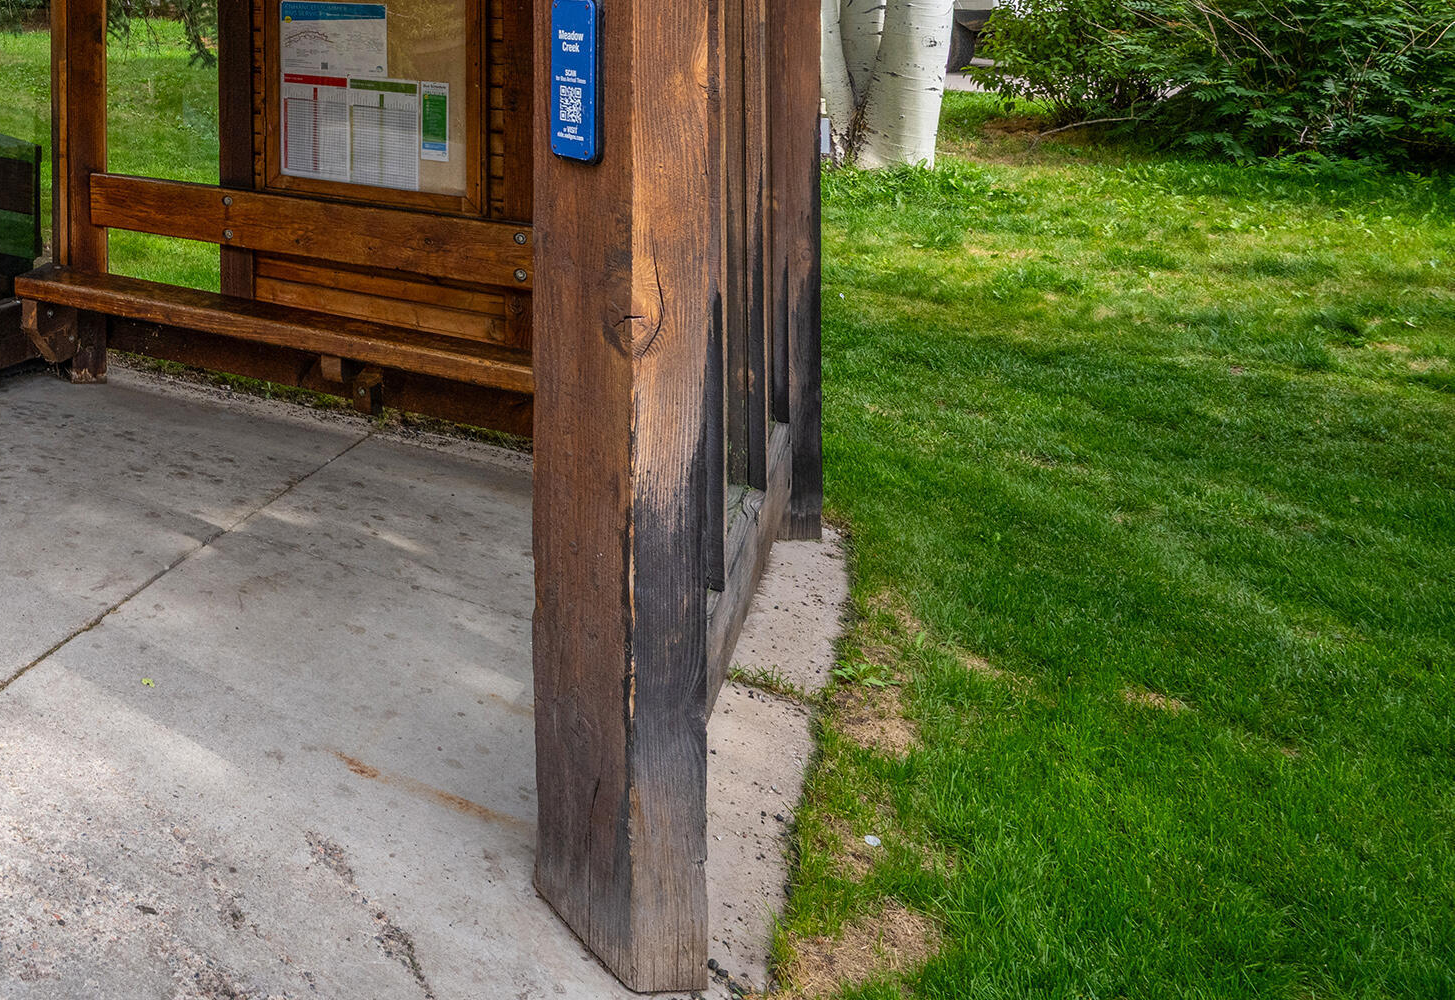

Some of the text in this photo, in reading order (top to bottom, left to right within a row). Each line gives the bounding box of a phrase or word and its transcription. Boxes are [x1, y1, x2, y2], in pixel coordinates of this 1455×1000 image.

[558, 29, 584, 41] Meadow
[562, 41, 580, 53] Creek
[565, 69, 577, 77] SCAN
